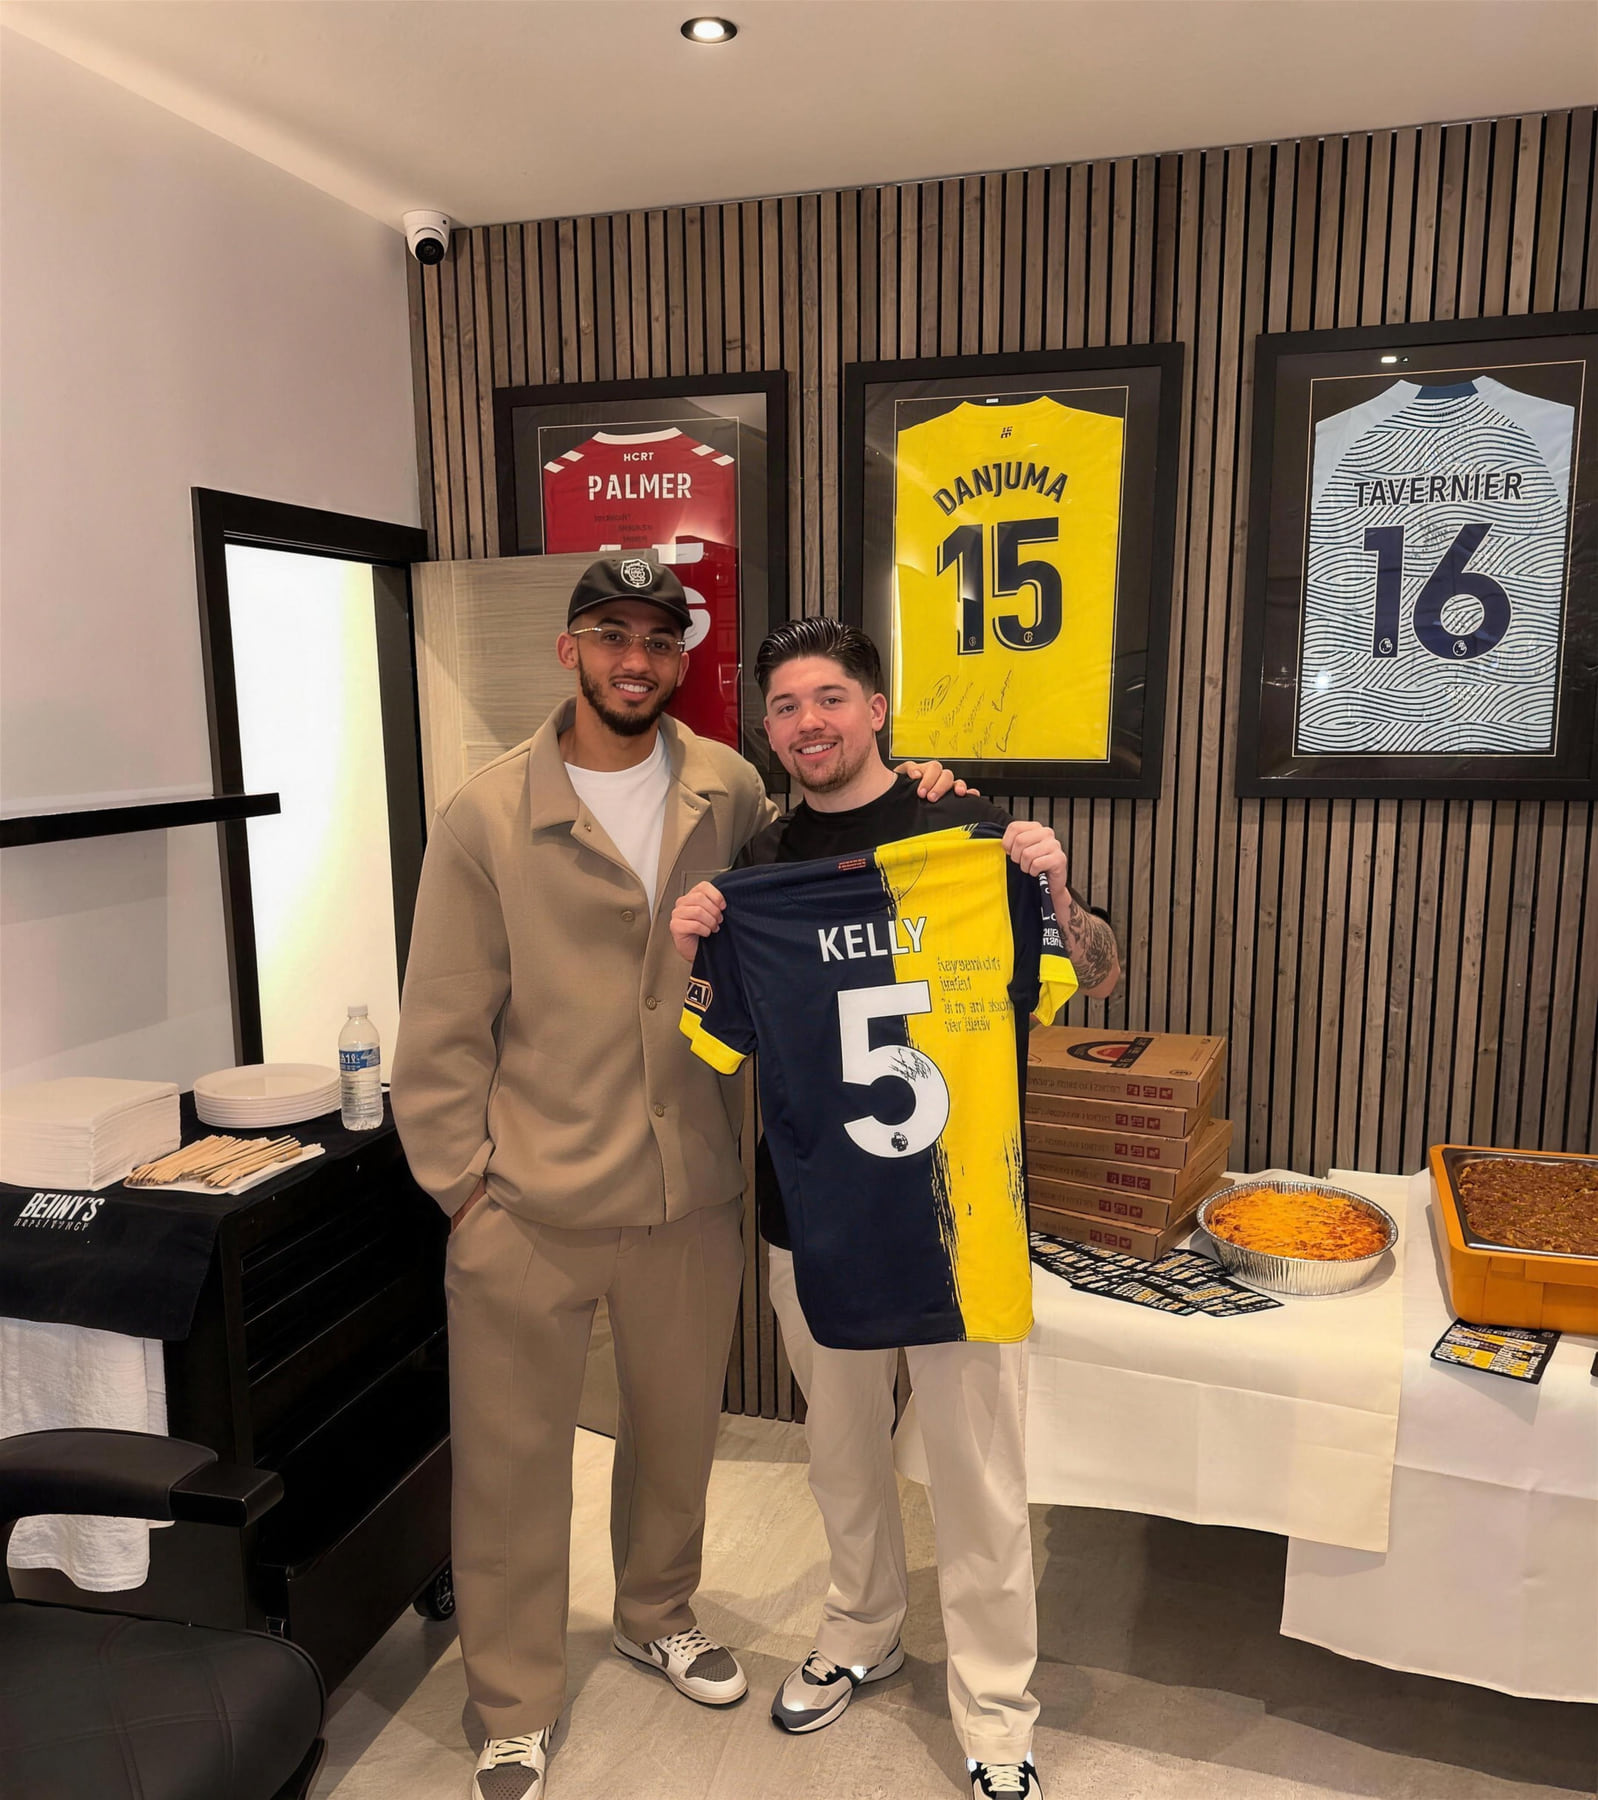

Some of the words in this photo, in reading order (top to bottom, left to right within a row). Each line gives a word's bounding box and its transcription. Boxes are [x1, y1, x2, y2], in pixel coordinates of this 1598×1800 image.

[623, 452, 655, 461] HCRT
[588, 473, 692, 500] PALMER
[933, 461, 1068, 516] DANJUMA
[1354, 472, 1523, 508] TAVERNIER
[937, 517, 1062, 655] 15
[1363, 522, 1512, 660] 16
[816, 917, 927, 962] KELLY
[837, 980, 950, 1158] 5
